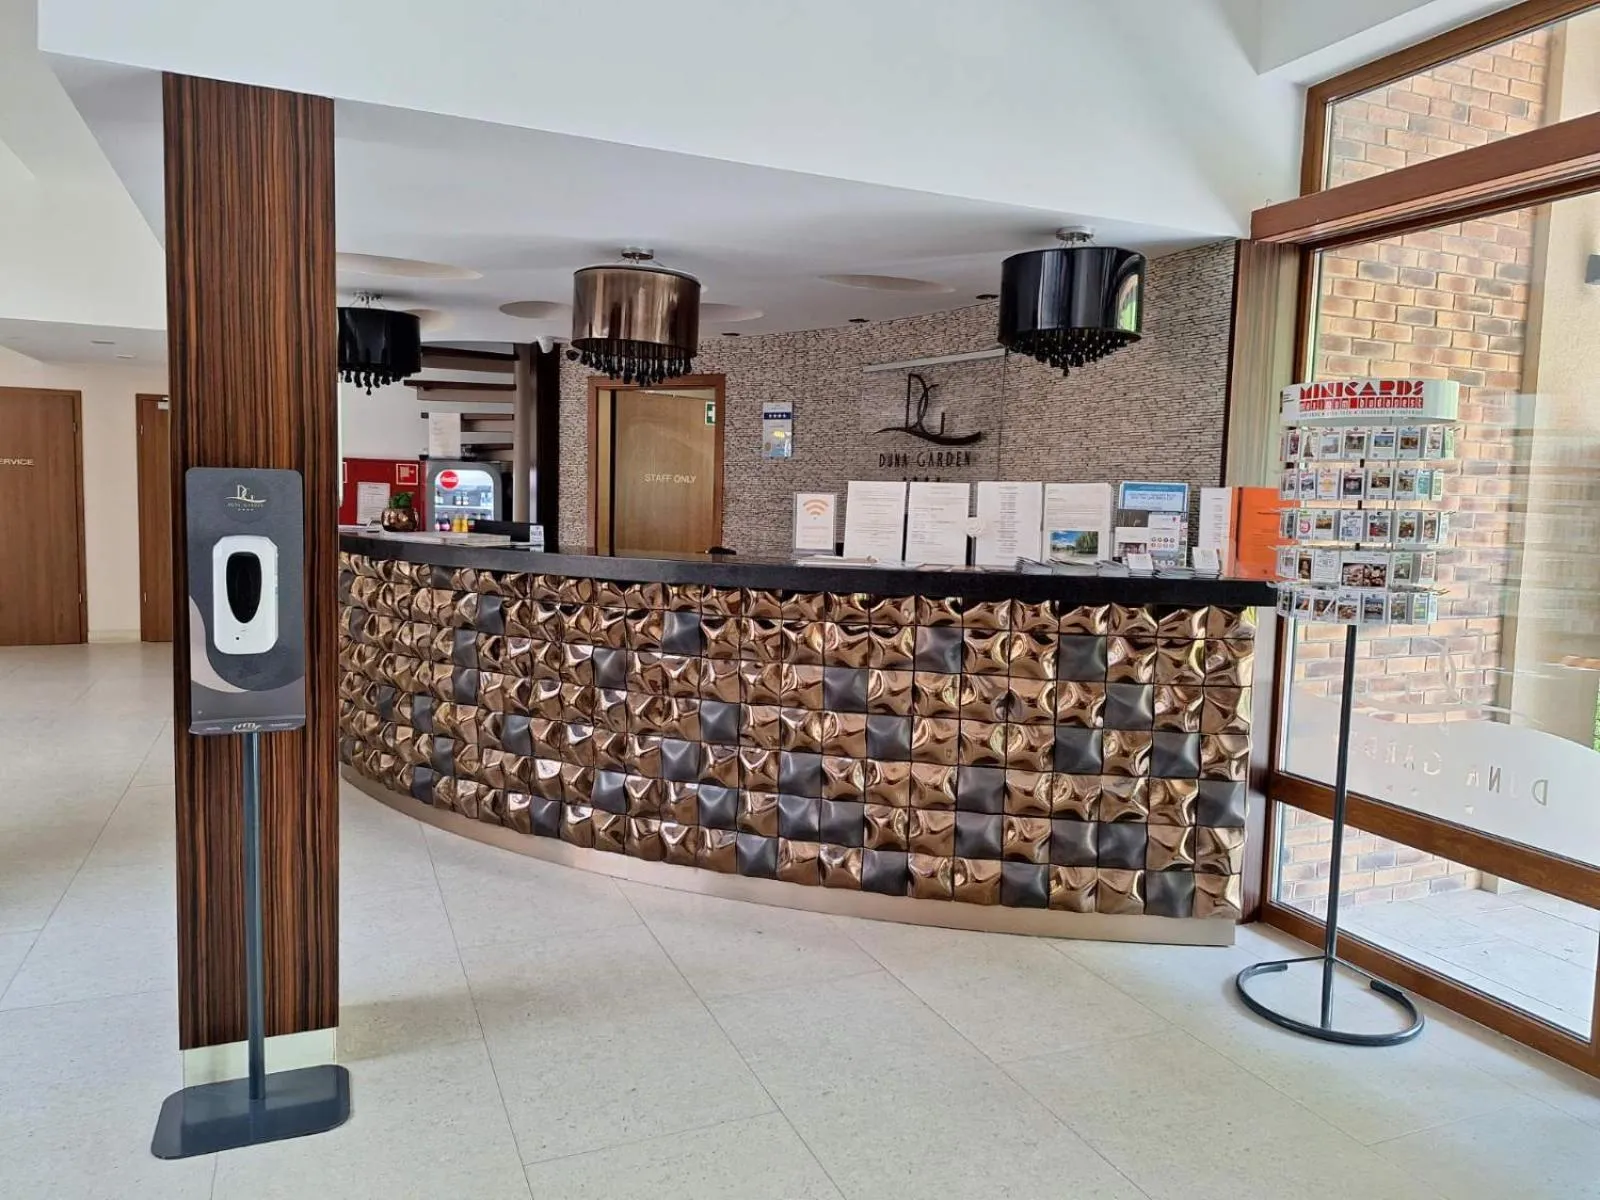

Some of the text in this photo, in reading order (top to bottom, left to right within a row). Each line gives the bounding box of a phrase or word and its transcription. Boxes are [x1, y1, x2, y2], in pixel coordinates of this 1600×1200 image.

[1300, 380, 1425, 399] MINICARDS
[917, 451, 972, 467] GARDEN
[644, 473, 697, 484] STAFF ONLY
